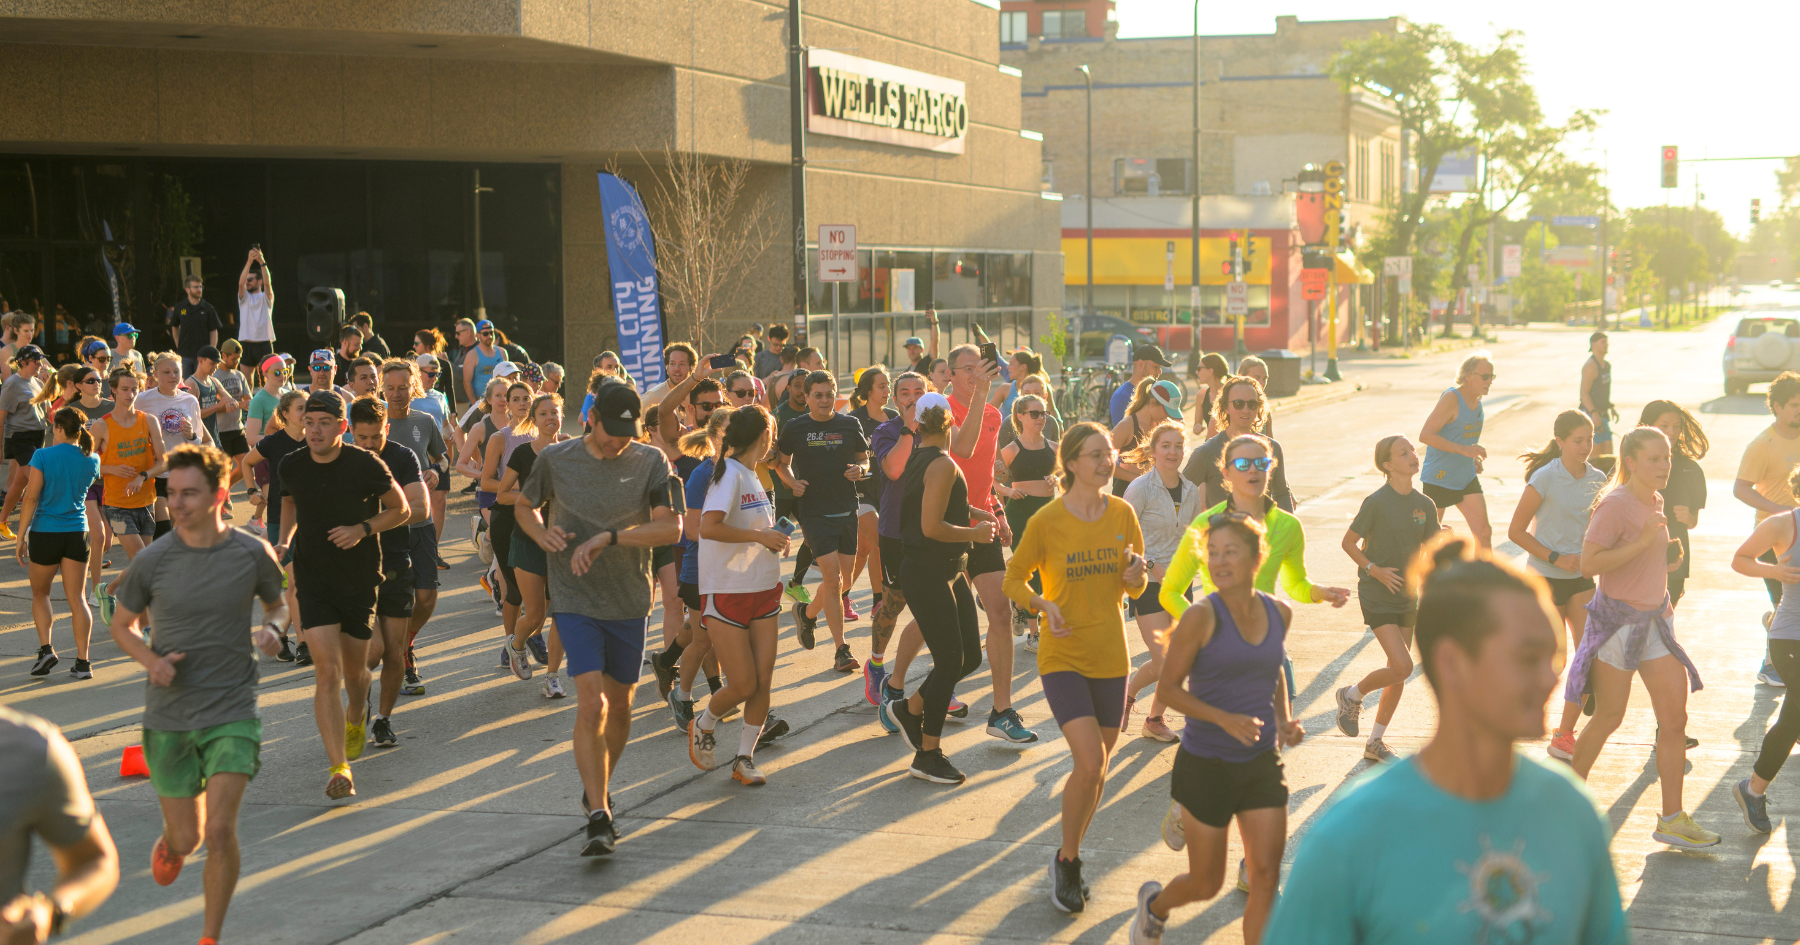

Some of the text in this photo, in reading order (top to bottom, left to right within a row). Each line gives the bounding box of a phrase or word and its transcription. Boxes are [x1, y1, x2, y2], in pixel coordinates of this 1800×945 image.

[819, 66, 969, 139] WELLS FARGO
[830, 230, 845, 243] NO
[821, 249, 855, 260] STOPPING
[1302, 271, 1325, 279] DETOUR
[1231, 285, 1244, 294] NO
[615, 281, 640, 336] CITY
[807, 432, 824, 441] 26.2
[117, 437, 147, 450] MILL CITY
[118, 446, 146, 459] RUNNING
[741, 493, 759, 505] Mt.
[1066, 547, 1118, 565] MILL CITY
[1066, 562, 1119, 579] RUNNING
